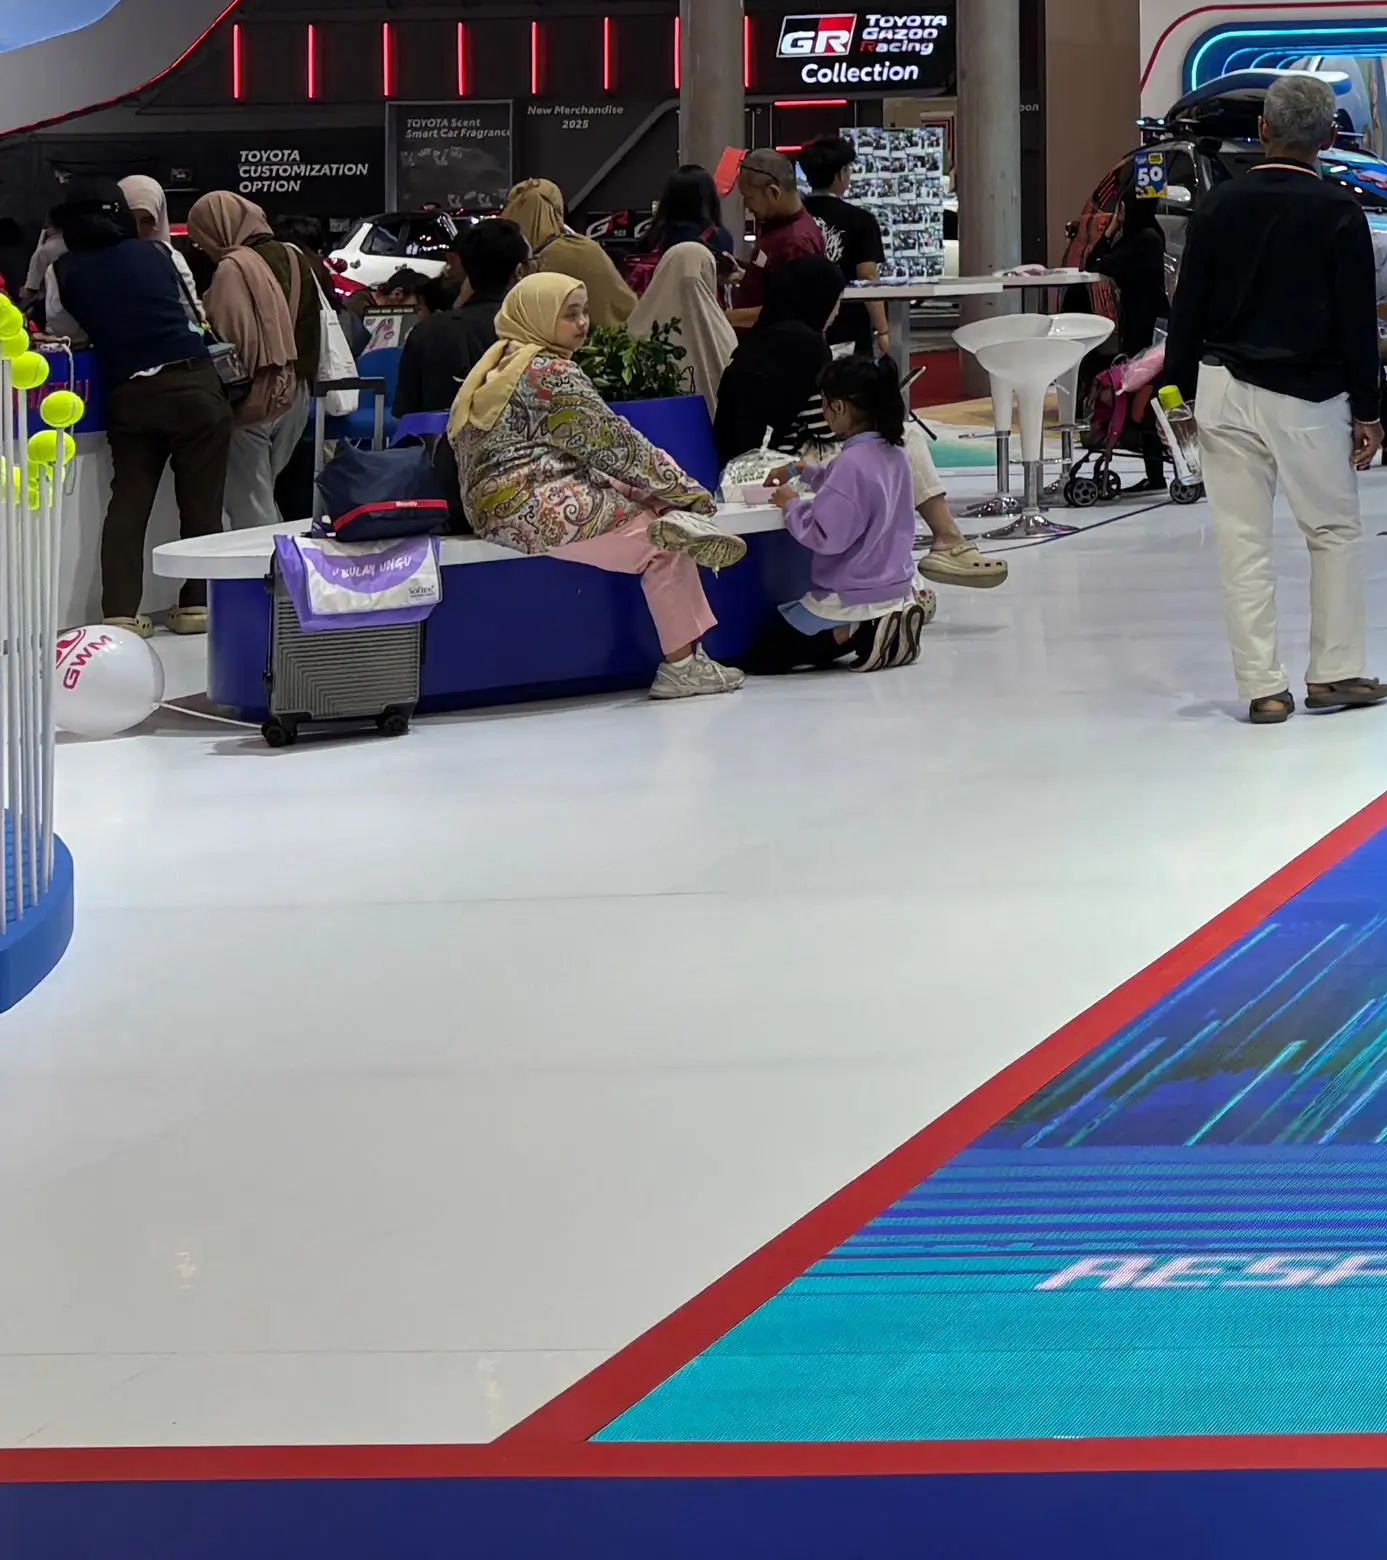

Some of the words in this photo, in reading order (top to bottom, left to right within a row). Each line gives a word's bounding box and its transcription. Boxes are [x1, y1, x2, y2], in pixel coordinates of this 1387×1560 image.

[865, 15, 947, 27] TOYOTA
[862, 28, 938, 40] GAZOO
[781, 31, 850, 54] GR
[860, 40, 934, 56] Racing
[801, 61, 919, 84] Collection
[527, 105, 552, 115] New
[554, 104, 624, 116] Merchandise
[407, 118, 449, 128] TOYOTA
[450, 118, 480, 128] Scent
[562, 119, 590, 129] 2025
[405, 129, 438, 139] Smart
[440, 128, 459, 138] Car
[239, 150, 301, 163] TOYOTA
[239, 164, 369, 178] CUSTOMIZATION
[1137, 165, 1163, 187] 50
[239, 180, 301, 193] OPTION
[63, 634, 112, 690] GWM
